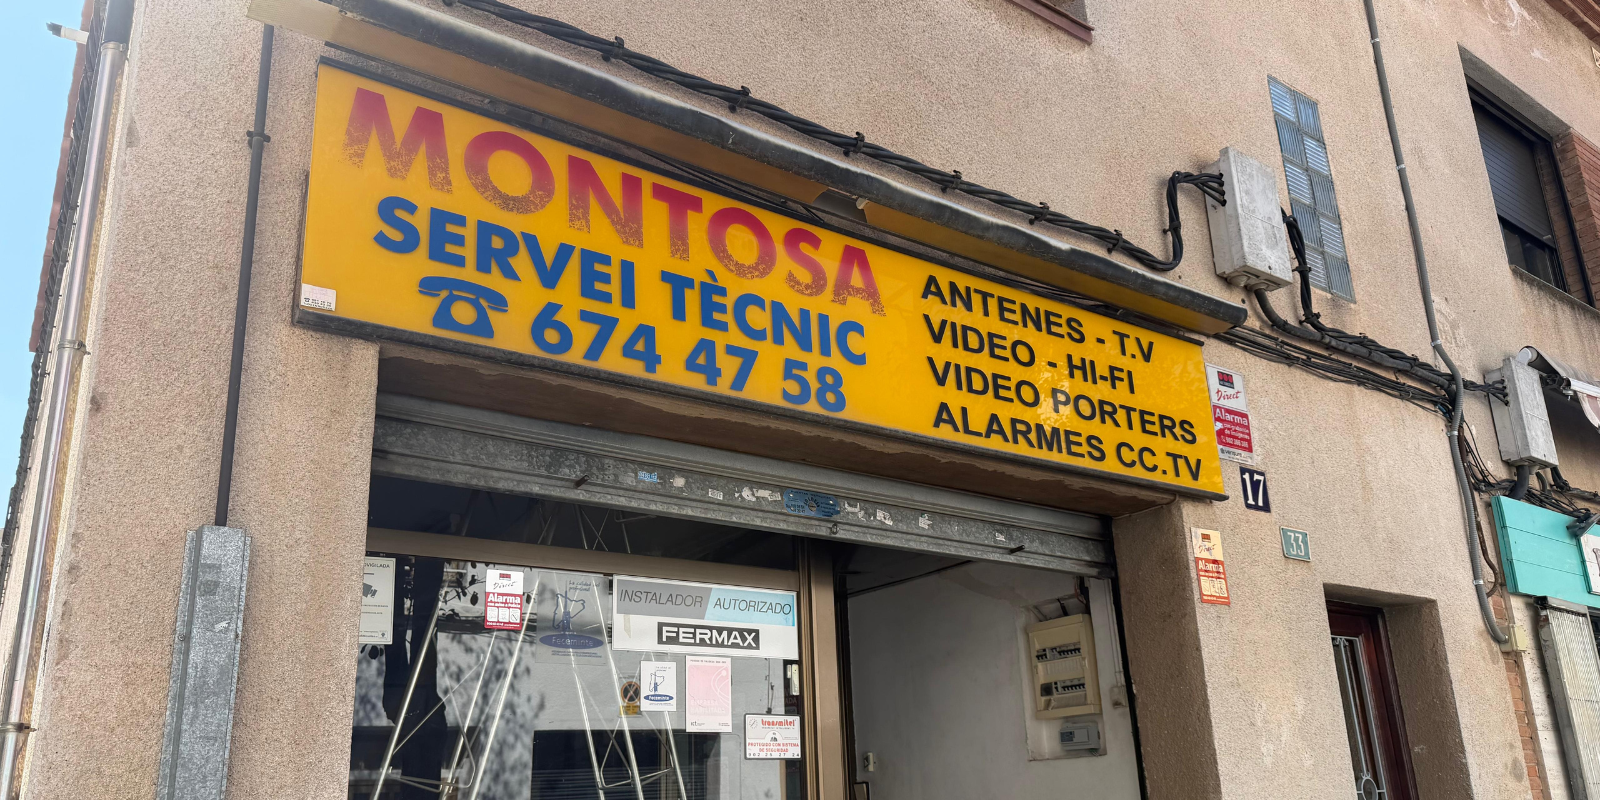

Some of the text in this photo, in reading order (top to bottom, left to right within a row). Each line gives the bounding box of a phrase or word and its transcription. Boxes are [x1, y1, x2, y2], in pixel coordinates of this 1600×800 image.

[340, 87, 887, 317] MONTOSA
[372, 196, 867, 365] SERVEI TÈCNIC
[921, 275, 1086, 344] ANTENES
[1112, 330, 1154, 363] T.V
[530, 302, 846, 413] 674 47 58
[923, 313, 1036, 368] VIDEO
[1067, 353, 1135, 395] HI-FI
[926, 356, 1198, 445] VIDEO PORTERS
[1215, 387, 1242, 402] Direct
[1215, 407, 1249, 426] Alarma
[933, 401, 1202, 482] ALARMES CC.TV
[1242, 472, 1265, 507] 17
[1287, 531, 1305, 557] 33
[1198, 559, 1224, 573] Alarma
[487, 592, 521, 604] Alarma
[619, 589, 792, 616] INSTALADOR AUTORIZADO
[662, 626, 757, 647] FERMAX
[761, 718, 795, 727] transmitel
